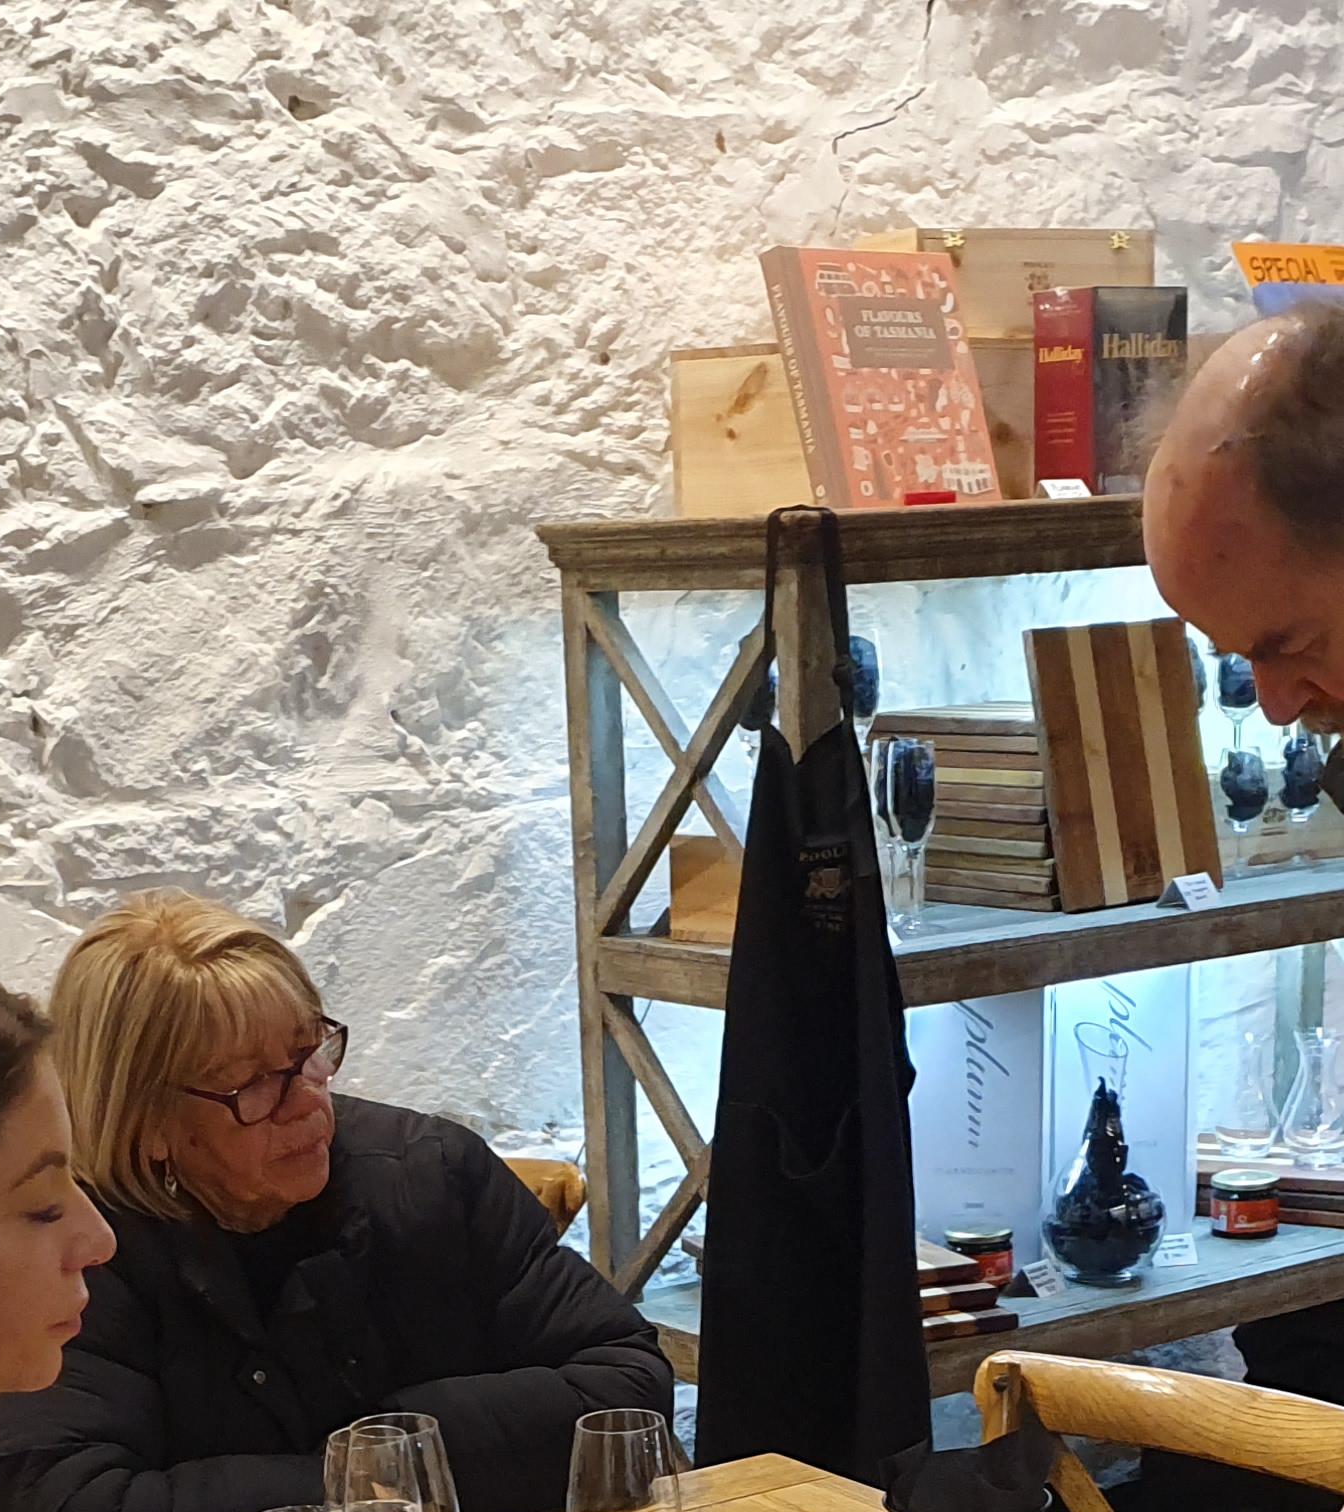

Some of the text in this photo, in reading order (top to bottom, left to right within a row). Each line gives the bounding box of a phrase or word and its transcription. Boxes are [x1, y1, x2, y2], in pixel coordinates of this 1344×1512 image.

[1250, 255, 1327, 284] SPECIAL
[861, 310, 923, 323] FLAVOURS
[854, 325, 937, 339] OF TASMANIA
[1039, 345, 1085, 363] Halliday
[1102, 332, 1186, 360] Halliday
[771, 283, 817, 455] FLAVOURS OF TASMANIA
